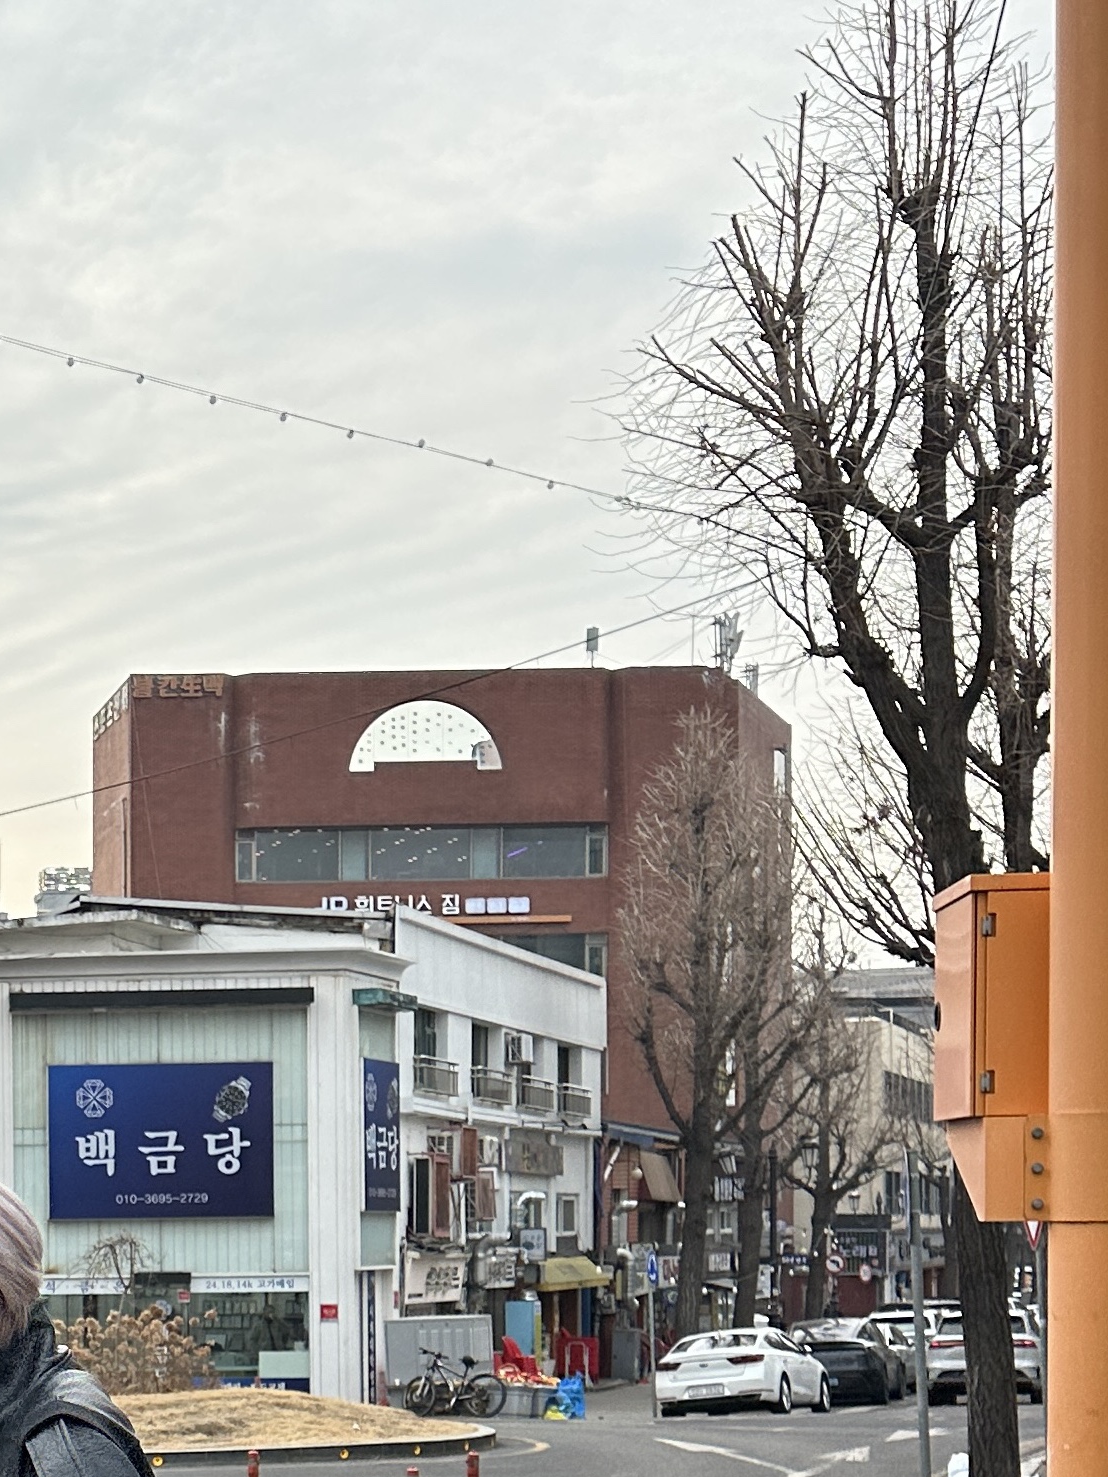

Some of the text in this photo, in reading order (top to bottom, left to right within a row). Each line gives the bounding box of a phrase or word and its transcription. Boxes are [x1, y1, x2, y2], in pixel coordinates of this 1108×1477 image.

[441, 894, 460, 915] 짐
[75, 1126, 252, 1177] 백금당
[366, 1122, 400, 1172] 백금당
[115, 1193, 209, 1204] 010-3695-2729
